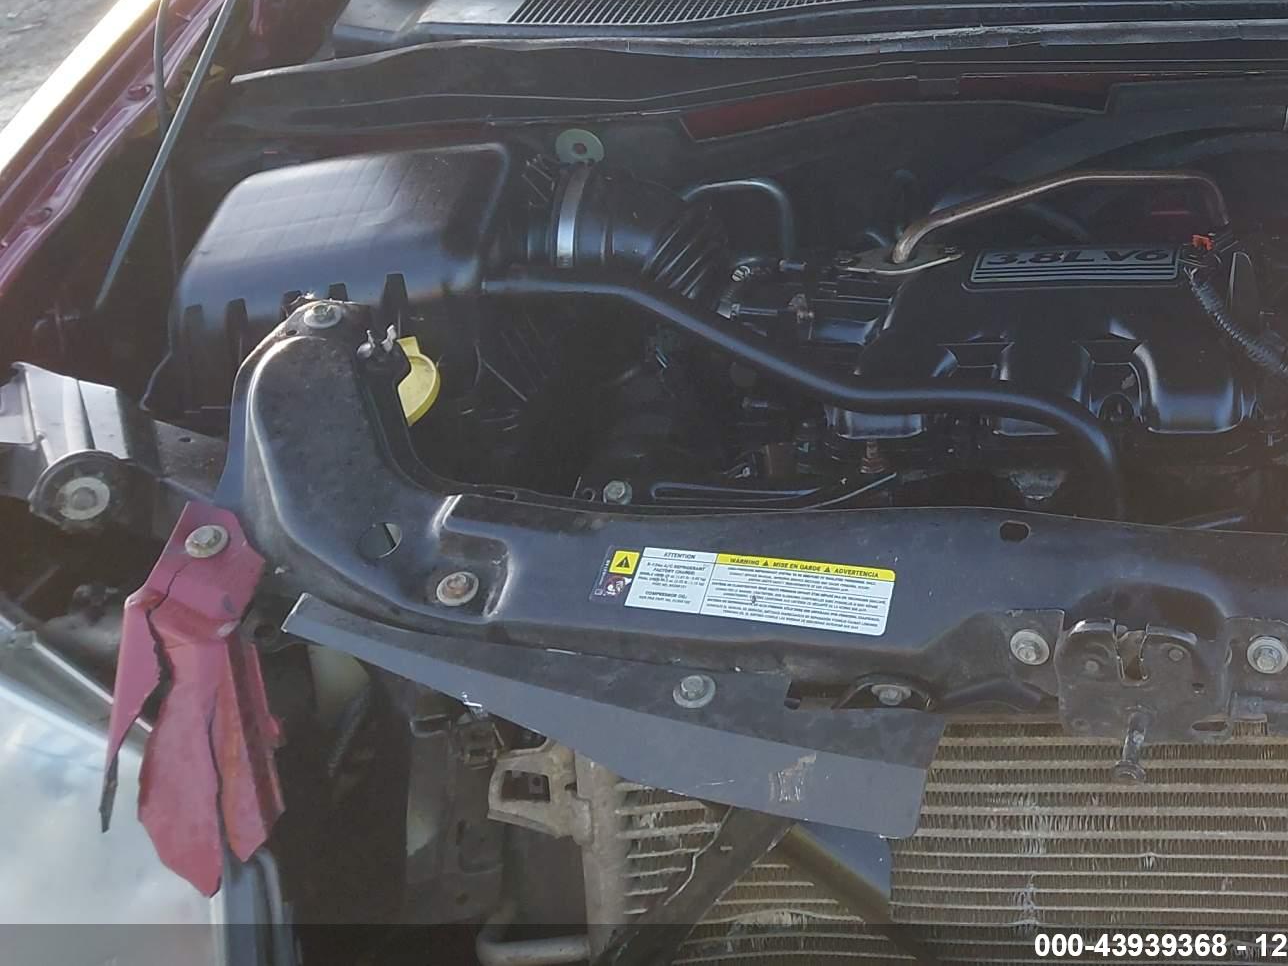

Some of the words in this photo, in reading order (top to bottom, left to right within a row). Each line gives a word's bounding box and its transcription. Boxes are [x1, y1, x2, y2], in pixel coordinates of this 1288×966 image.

[987, 249, 1095, 265] 3.8L
[664, 552, 697, 560] ATTENTION
[729, 558, 760, 566] WARNING
[799, 564, 821, 572] GARDE
[834, 568, 879, 578] ADVERTENCIA
